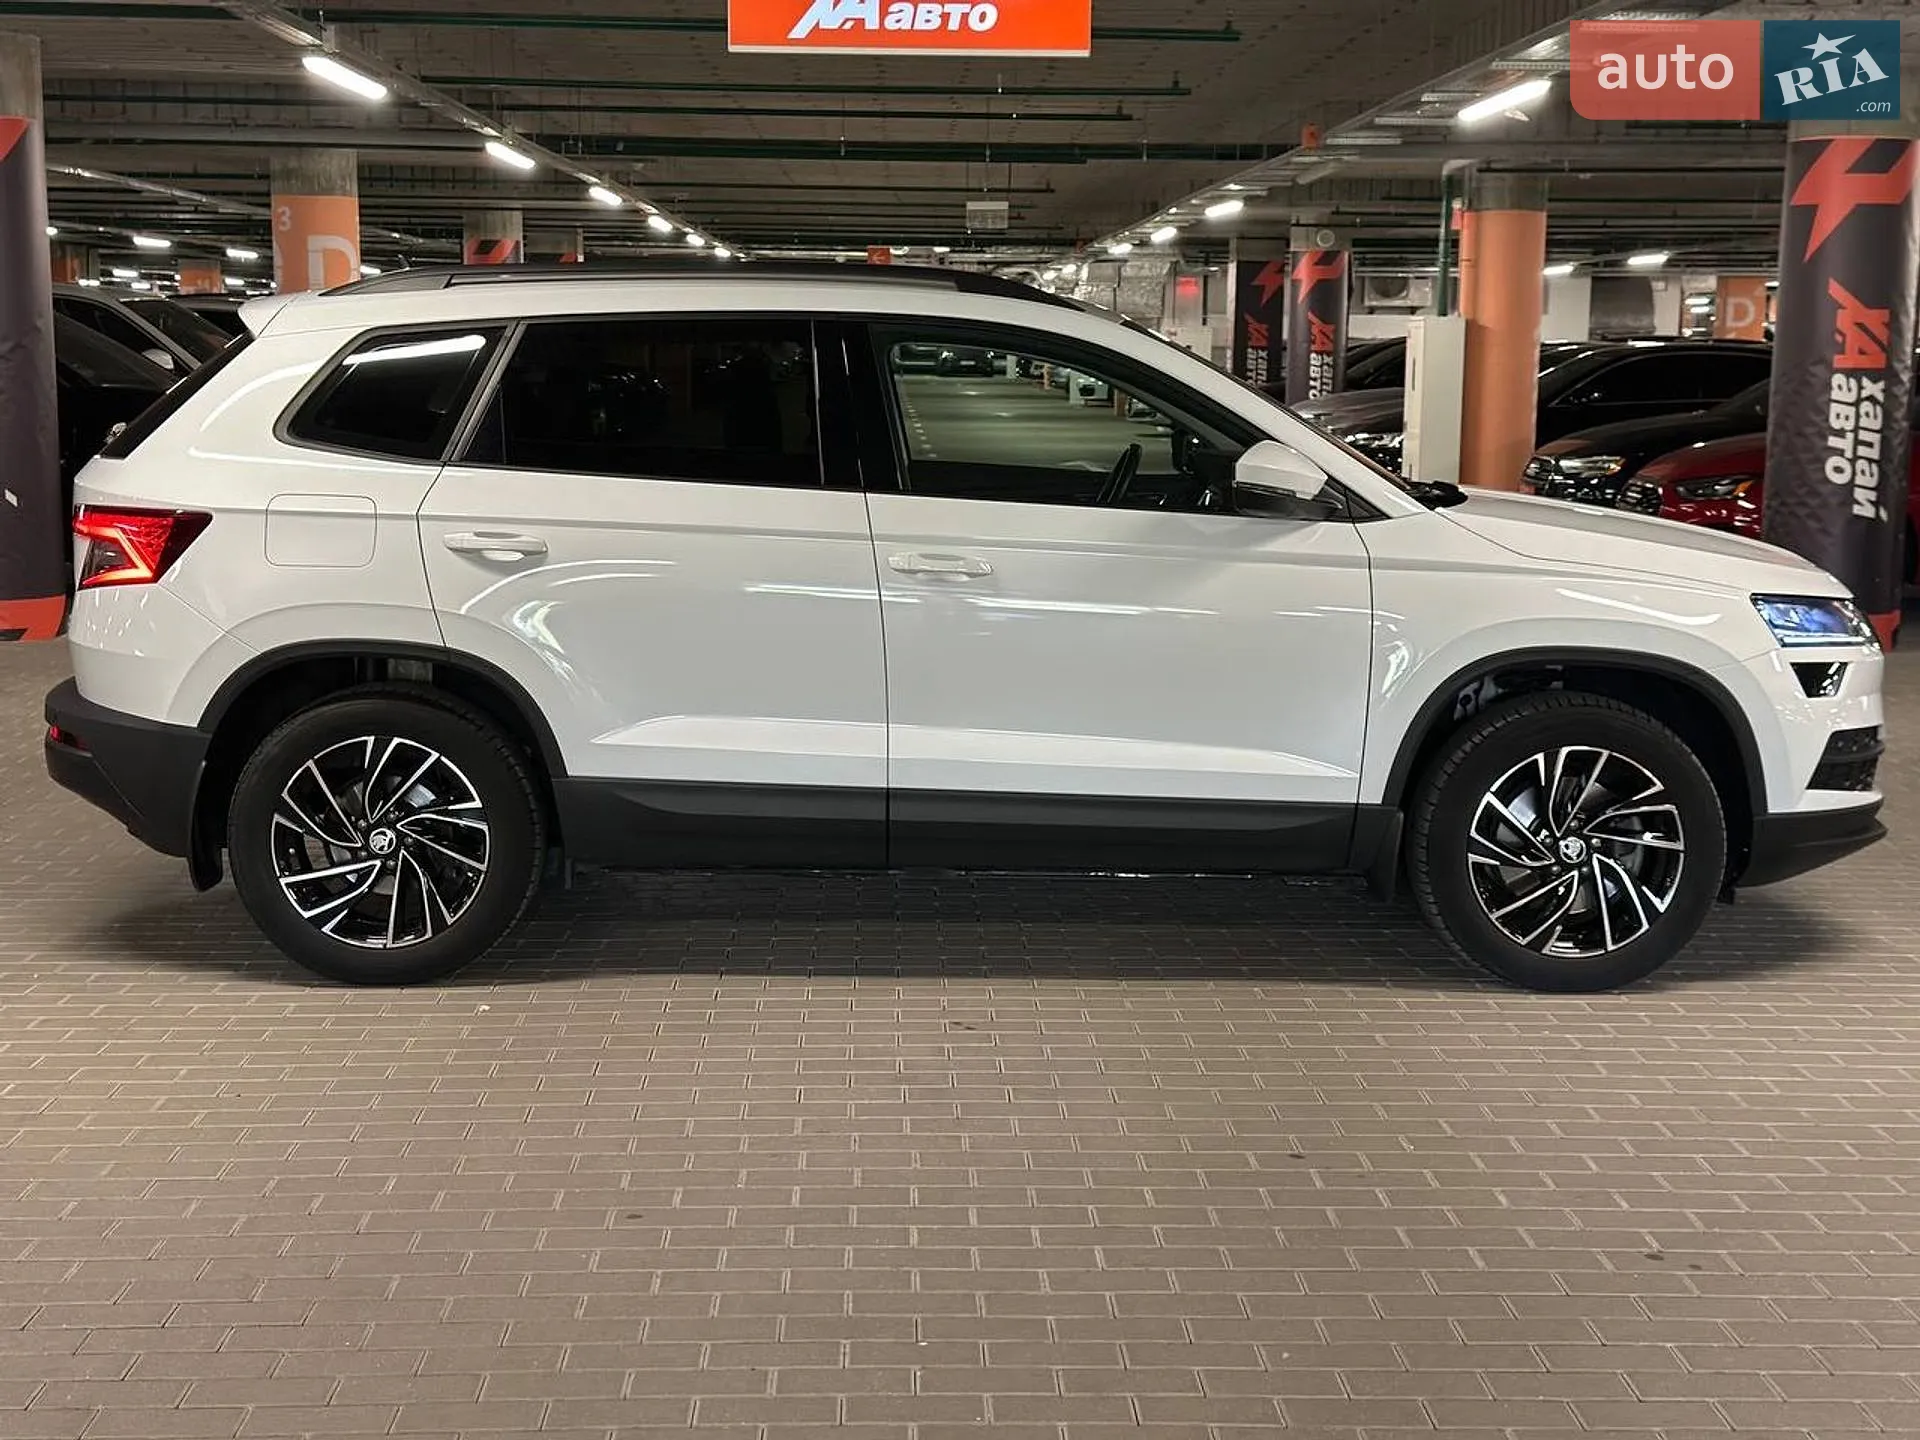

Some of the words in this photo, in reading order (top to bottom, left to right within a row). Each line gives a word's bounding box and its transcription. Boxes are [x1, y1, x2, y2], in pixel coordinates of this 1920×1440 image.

[883, 2, 999, 32] авто
[1726, 297, 1756, 328] D
[1824, 373, 1858, 485] авто
[1853, 376, 1889, 522] хапай
